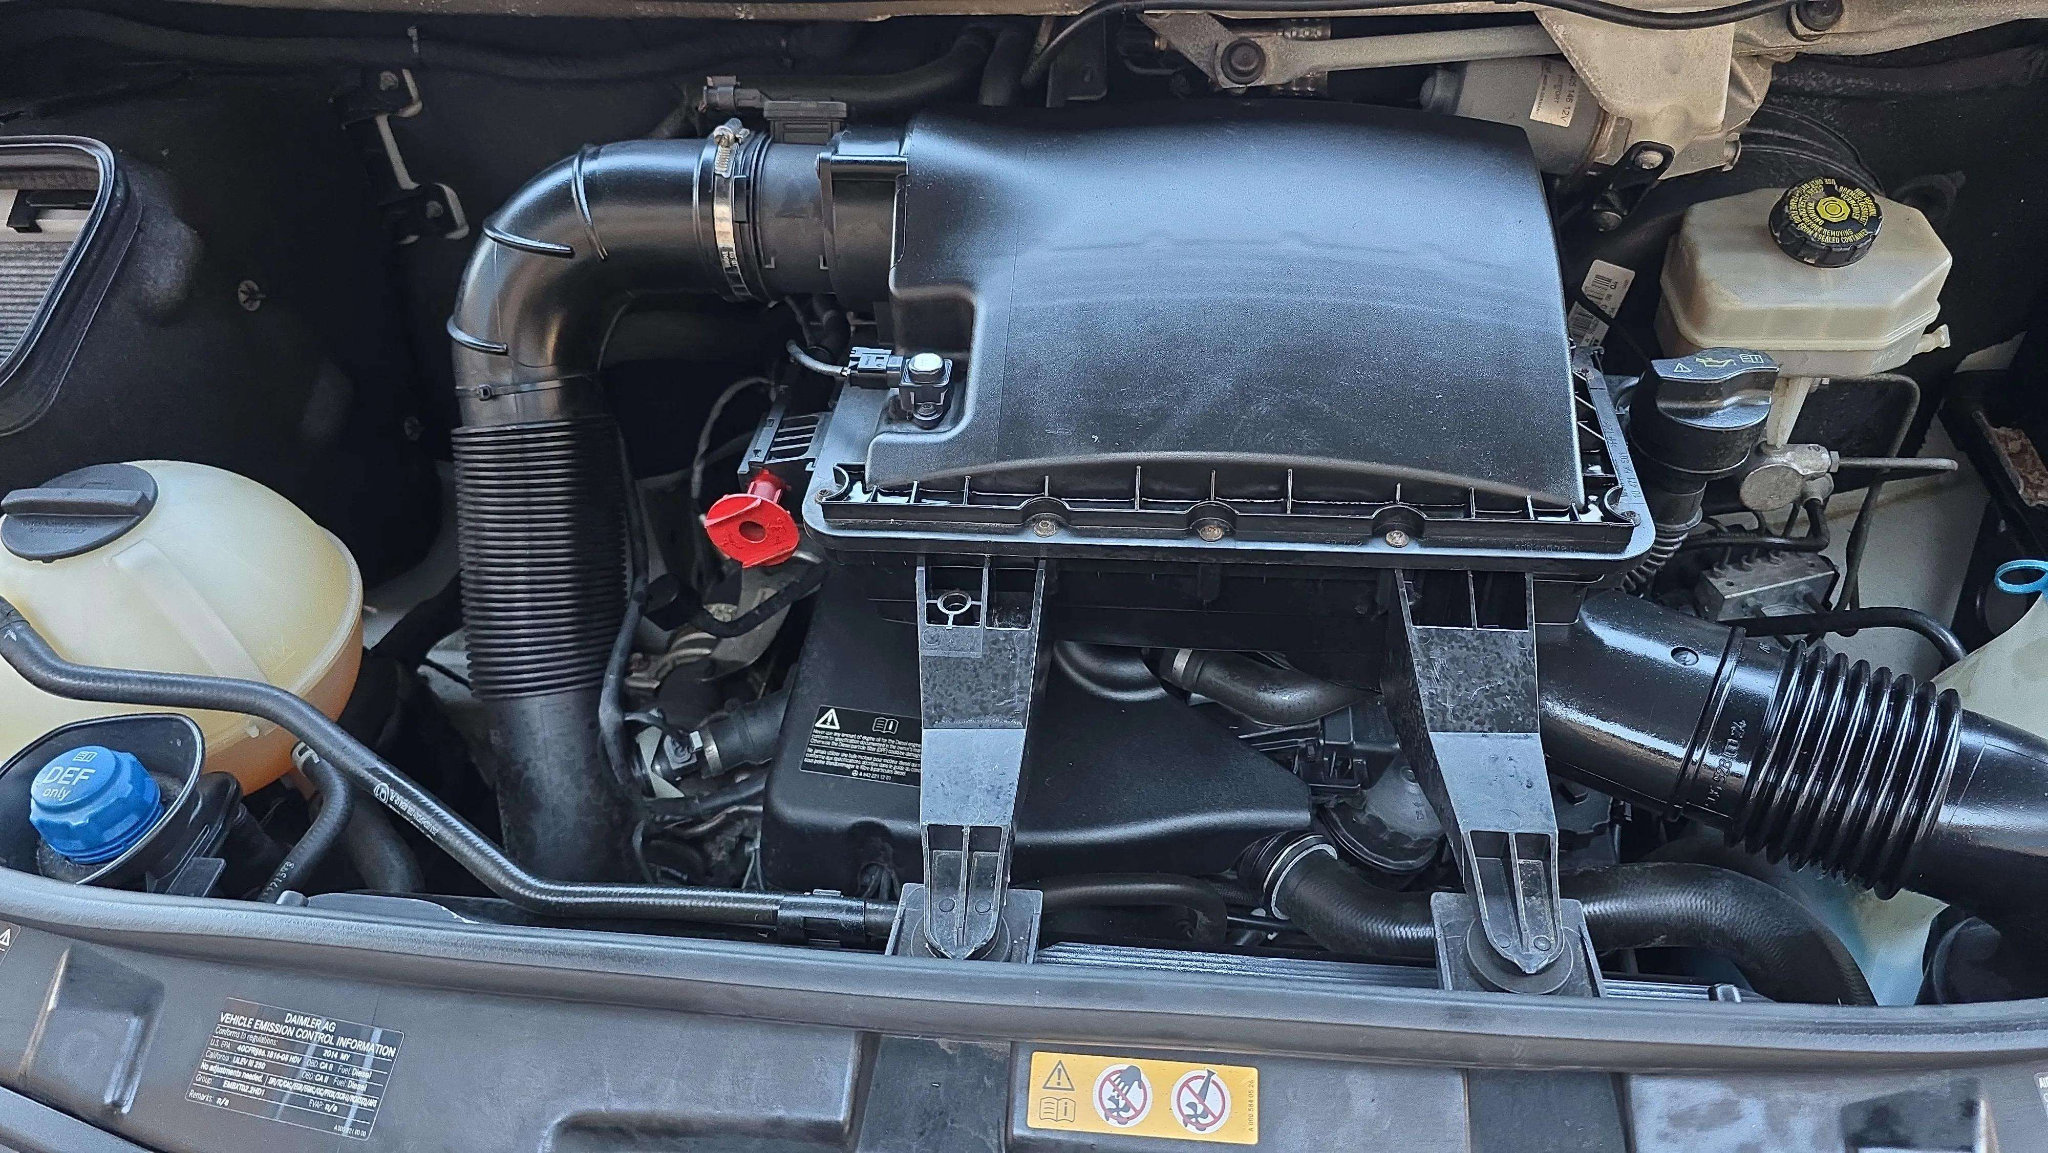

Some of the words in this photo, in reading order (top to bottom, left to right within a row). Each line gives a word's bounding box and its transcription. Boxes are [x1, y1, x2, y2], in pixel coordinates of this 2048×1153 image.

[1797, 223, 1814, 236] FROM
[1818, 233, 1840, 243] SEALED
[1822, 228, 1854, 236] REMOVING
[42, 766, 96, 786] DEF
[42, 787, 71, 801] only
[284, 1013, 322, 1029] DAIMLER
[321, 1021, 336, 1032] AG
[214, 1026, 241, 1038] Conforms
[218, 1012, 254, 1028] VEHICLE
[253, 1019, 295, 1036] EMISSION
[294, 1028, 336, 1045] CONTROL
[335, 1036, 396, 1057] INFORMATION
[322, 1049, 338, 1059] 2014
[339, 1053, 350, 1061] MY
[199, 1061, 210, 1070] No
[208, 1063, 244, 1079] adjustments
[231, 1055, 248, 1065] ULEV
[313, 1073, 325, 1082] CA
[346, 1080, 367, 1091] Diesel
[288, 1055, 301, 1063] HDV
[318, 1061, 330, 1069] CA
[350, 1067, 372, 1079] Diesel
[215, 1095, 230, 1106] n/a
[323, 1102, 338, 1113] n/a
